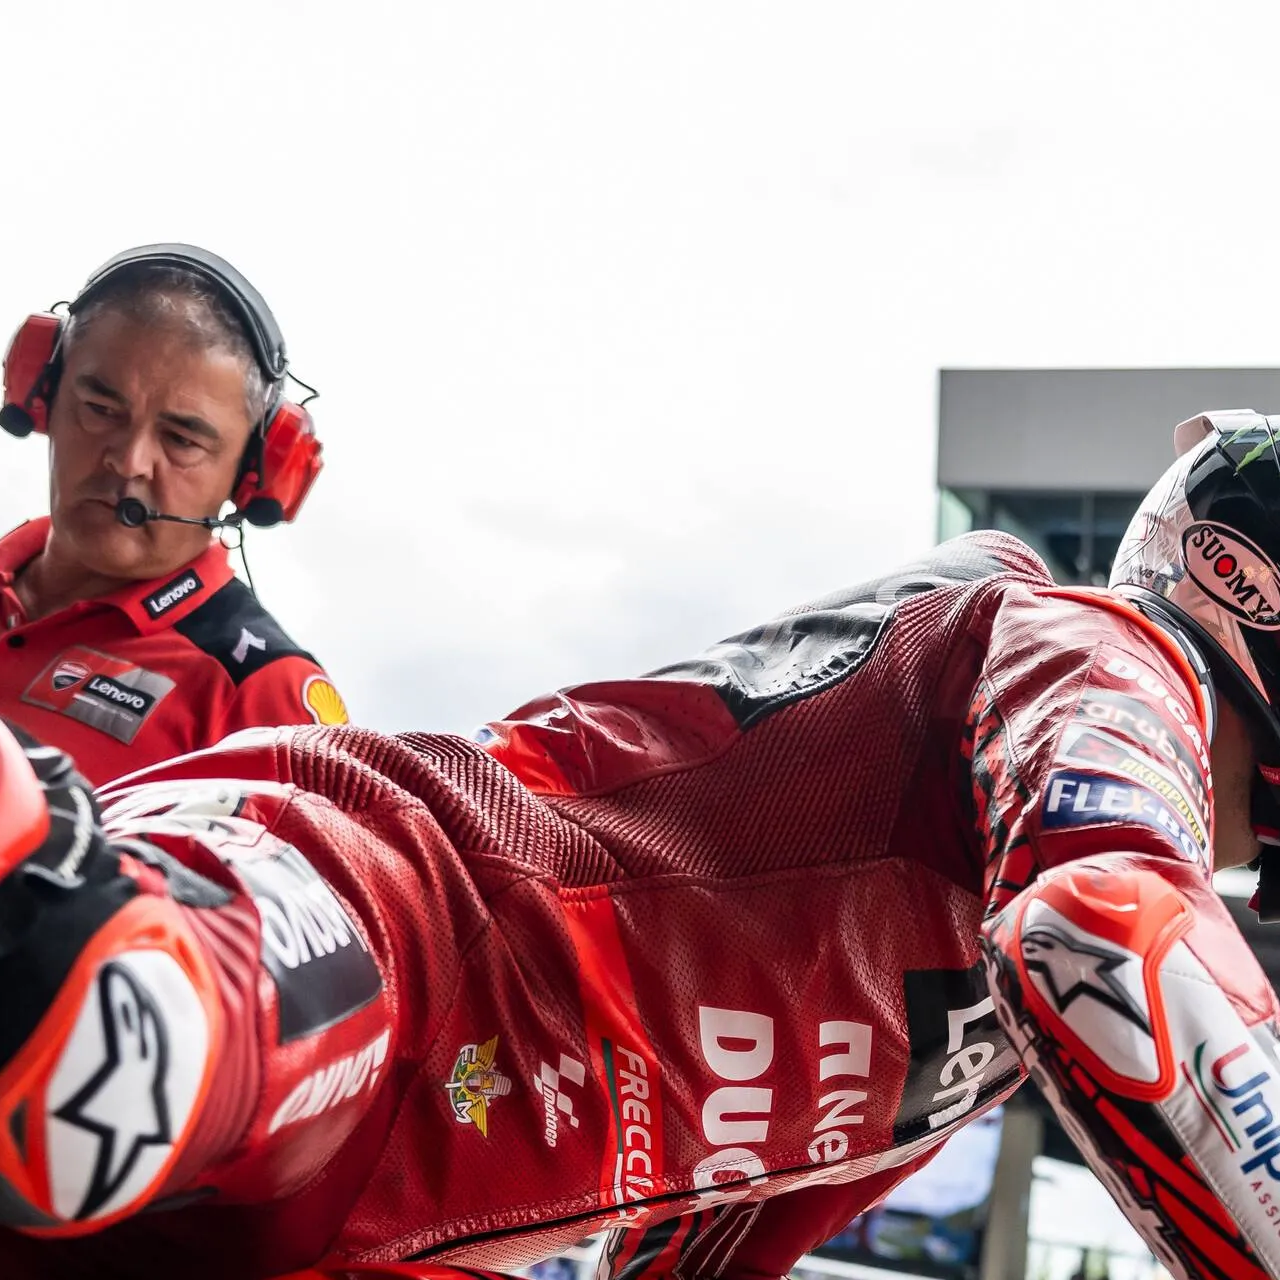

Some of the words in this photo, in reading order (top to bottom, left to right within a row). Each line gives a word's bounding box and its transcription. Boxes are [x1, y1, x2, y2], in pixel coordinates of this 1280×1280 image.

[1192, 527, 1275, 619] SUOMY
[149, 576, 197, 614] Lenovo
[89, 677, 146, 709] Lenovo
